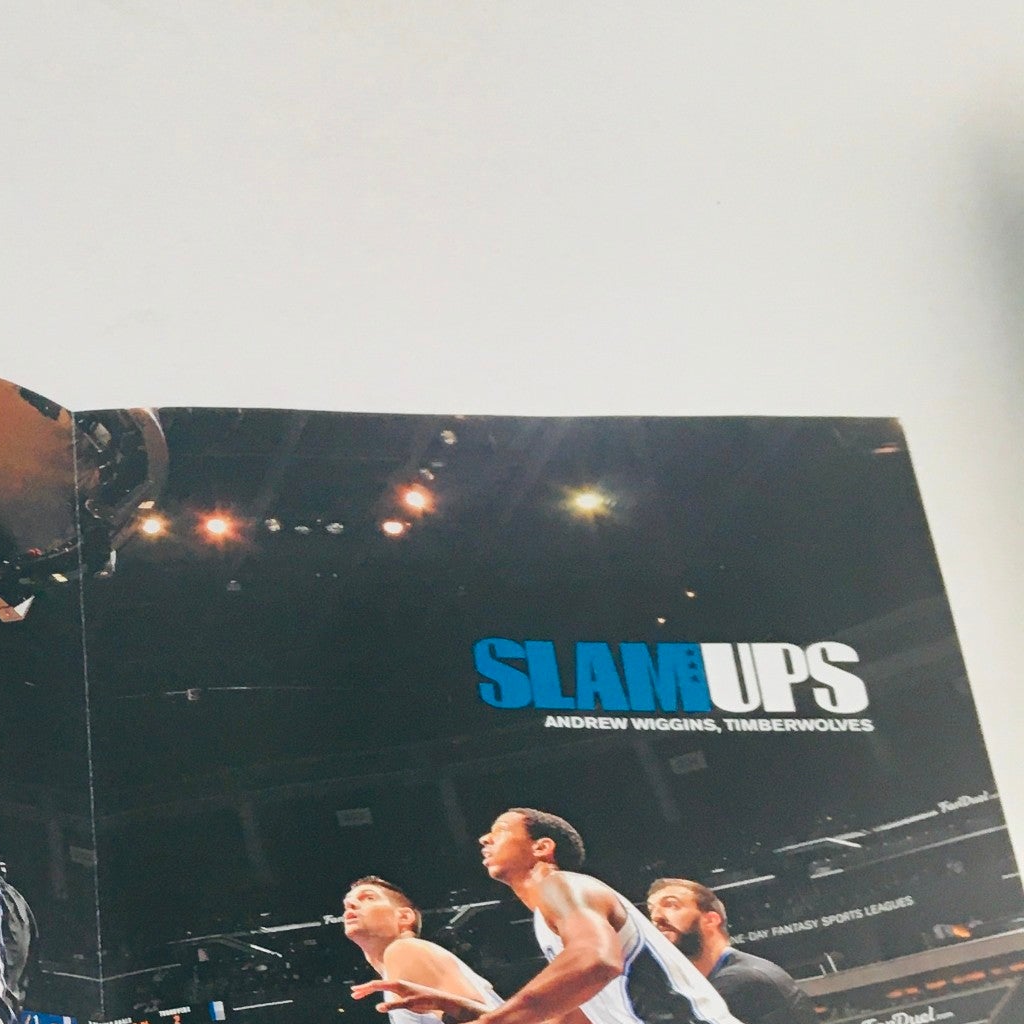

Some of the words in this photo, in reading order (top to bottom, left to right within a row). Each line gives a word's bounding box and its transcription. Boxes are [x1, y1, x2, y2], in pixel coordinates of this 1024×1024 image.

[543, 714, 630, 731] ANDREW
[631, 716, 723, 735] WIGGINS,
[723, 716, 876, 733] TIMBERWOLVES
[771, 918, 820, 937] FANTASY
[821, 907, 864, 927] SPORTS
[864, 894, 916, 917] LEAGUES
